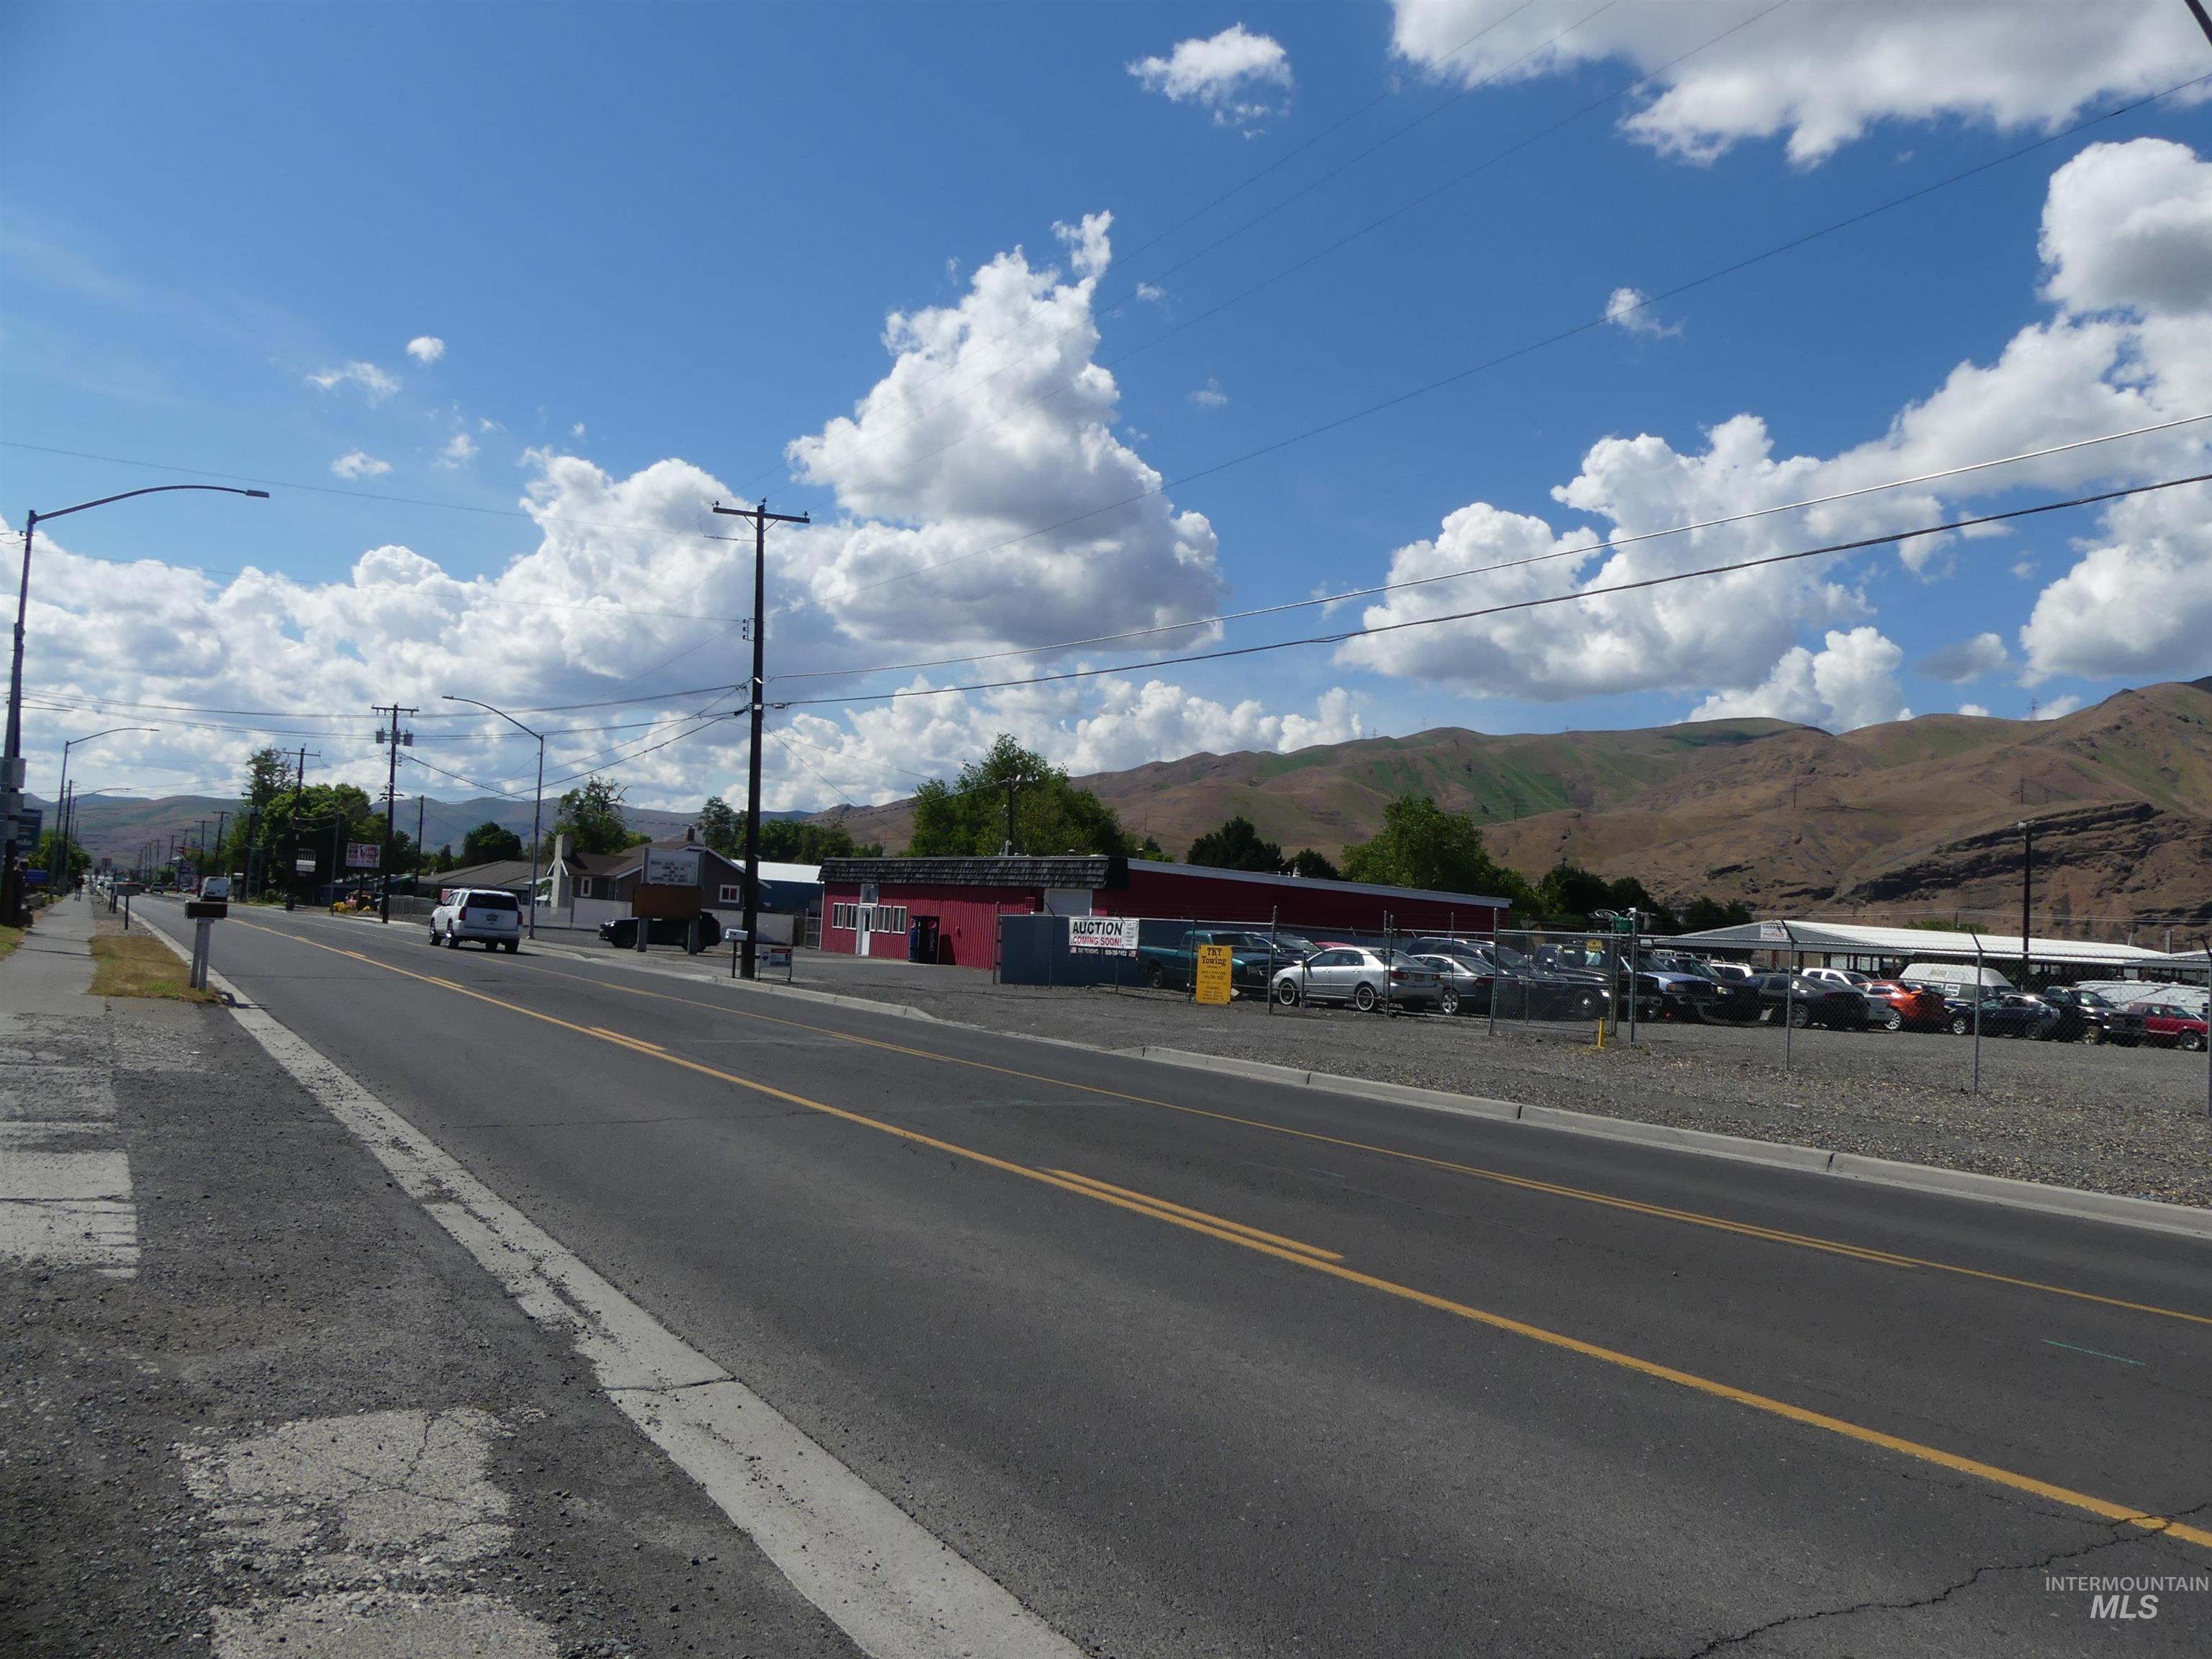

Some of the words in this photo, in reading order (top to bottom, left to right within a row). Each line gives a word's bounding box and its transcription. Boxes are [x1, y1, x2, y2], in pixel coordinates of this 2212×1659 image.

[1072, 922, 1123, 935] AUCTION
[1073, 936, 1099, 945] COMING
[1100, 937, 1123, 947] SOON!
[1207, 947, 1223, 956] TKT
[1202, 956, 1227, 967] Towing
